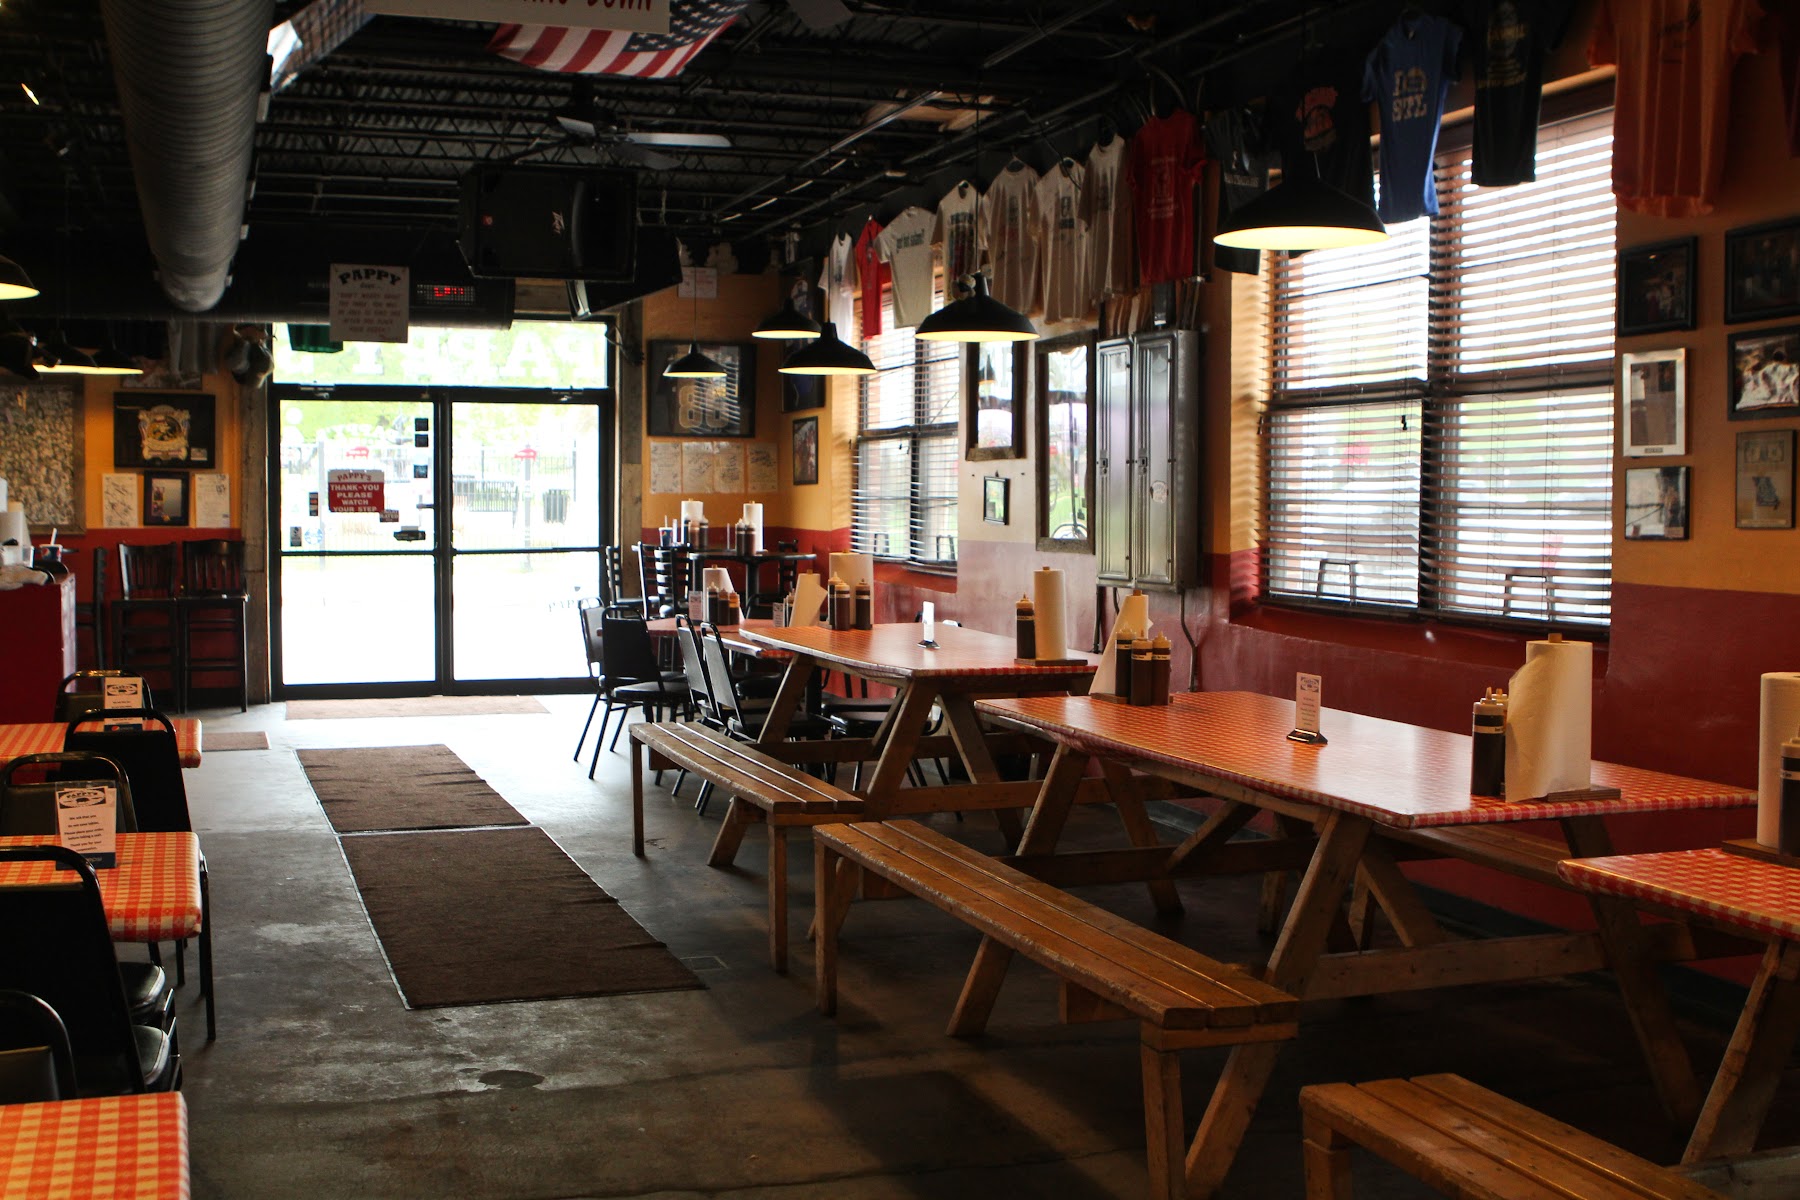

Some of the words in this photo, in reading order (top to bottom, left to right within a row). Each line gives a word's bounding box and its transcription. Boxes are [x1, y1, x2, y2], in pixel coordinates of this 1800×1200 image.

[1392, 93, 1428, 122] STL
[339, 268, 401, 286] PAPPY
[337, 472, 372, 481] PAPPY'S
